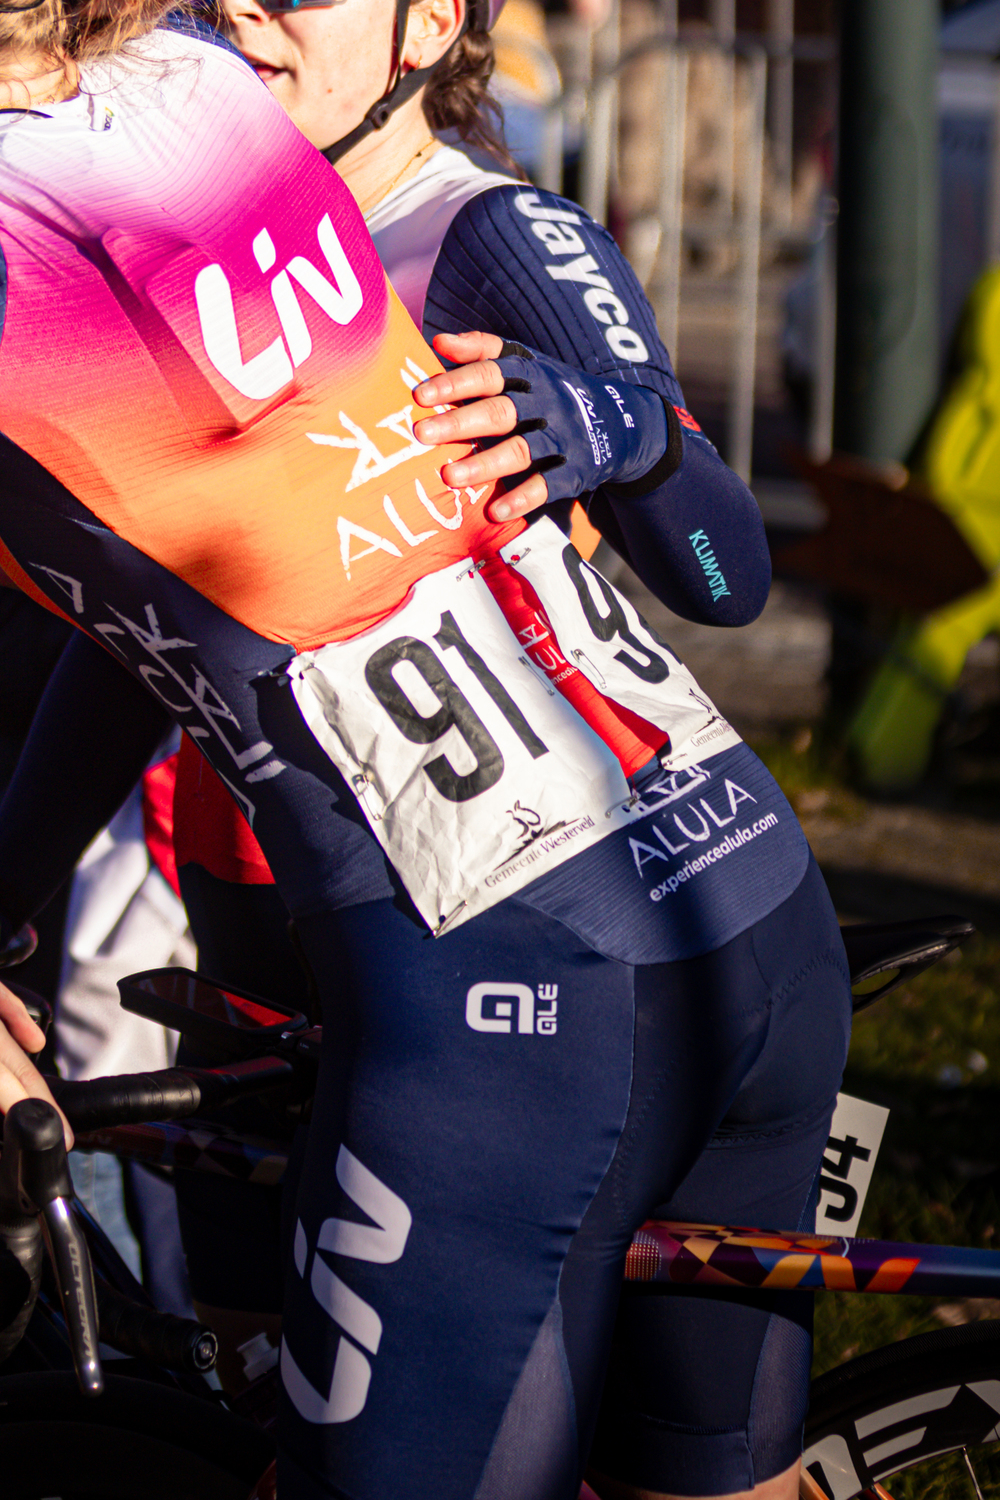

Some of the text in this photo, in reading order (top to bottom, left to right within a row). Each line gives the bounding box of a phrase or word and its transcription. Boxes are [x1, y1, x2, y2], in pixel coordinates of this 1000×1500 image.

[194, 212, 364, 400] Liv
[514, 191, 650, 364] Jayco
[364, 609, 550, 803] 91
[628, 778, 758, 880] ALULA
[649, 810, 779, 902] experiencealula.com
